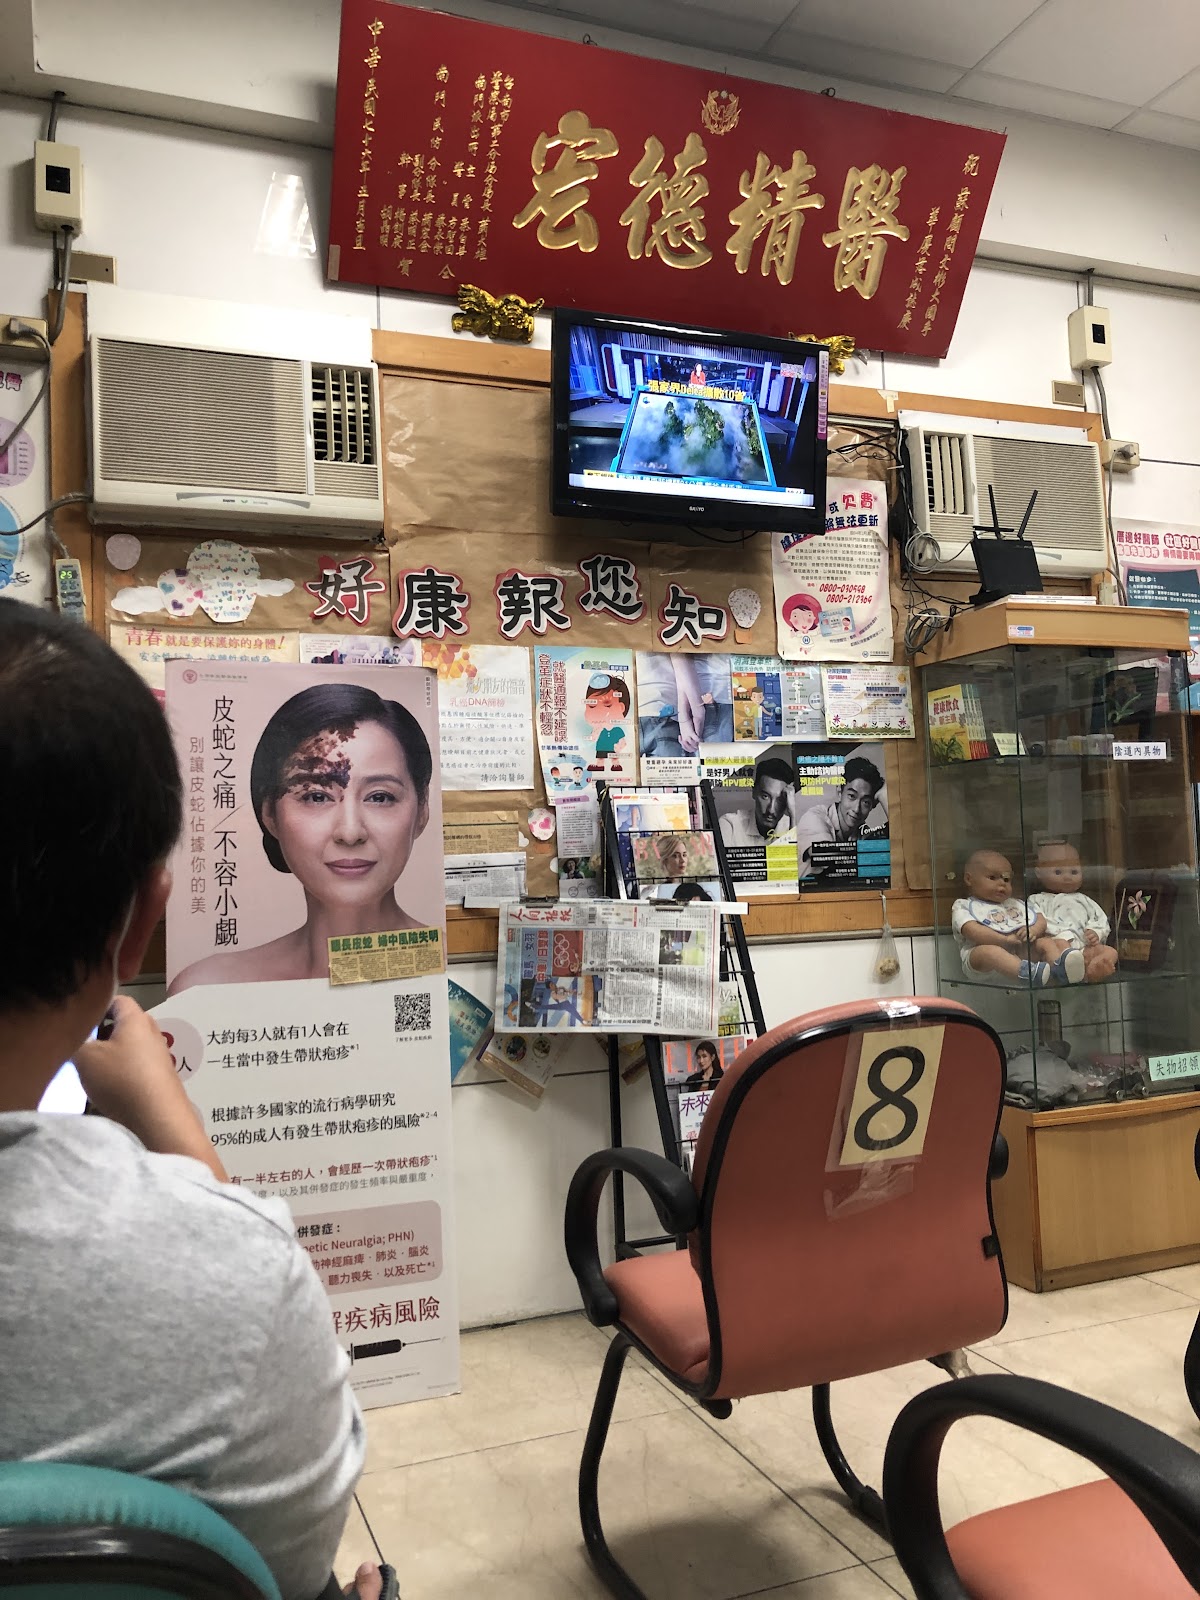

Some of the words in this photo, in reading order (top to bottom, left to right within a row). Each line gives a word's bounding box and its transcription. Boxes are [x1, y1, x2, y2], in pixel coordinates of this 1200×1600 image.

[962, 153, 980, 177] 祝
[1114, 746, 1161, 757] 陰道內異物
[189, 737, 206, 914] 別讓皮蛇佔據你的美
[206, 1022, 350, 1046] 大約每3人就有1人會在
[1155, 1055, 1200, 1077] 失物招領
[211, 1092, 396, 1123] 根據許多國家的流行病學研究
[853, 1045, 926, 1151] 8
[331, 1235, 385, 1250] Neuralgia;
[388, 1230, 414, 1243] PHN)
